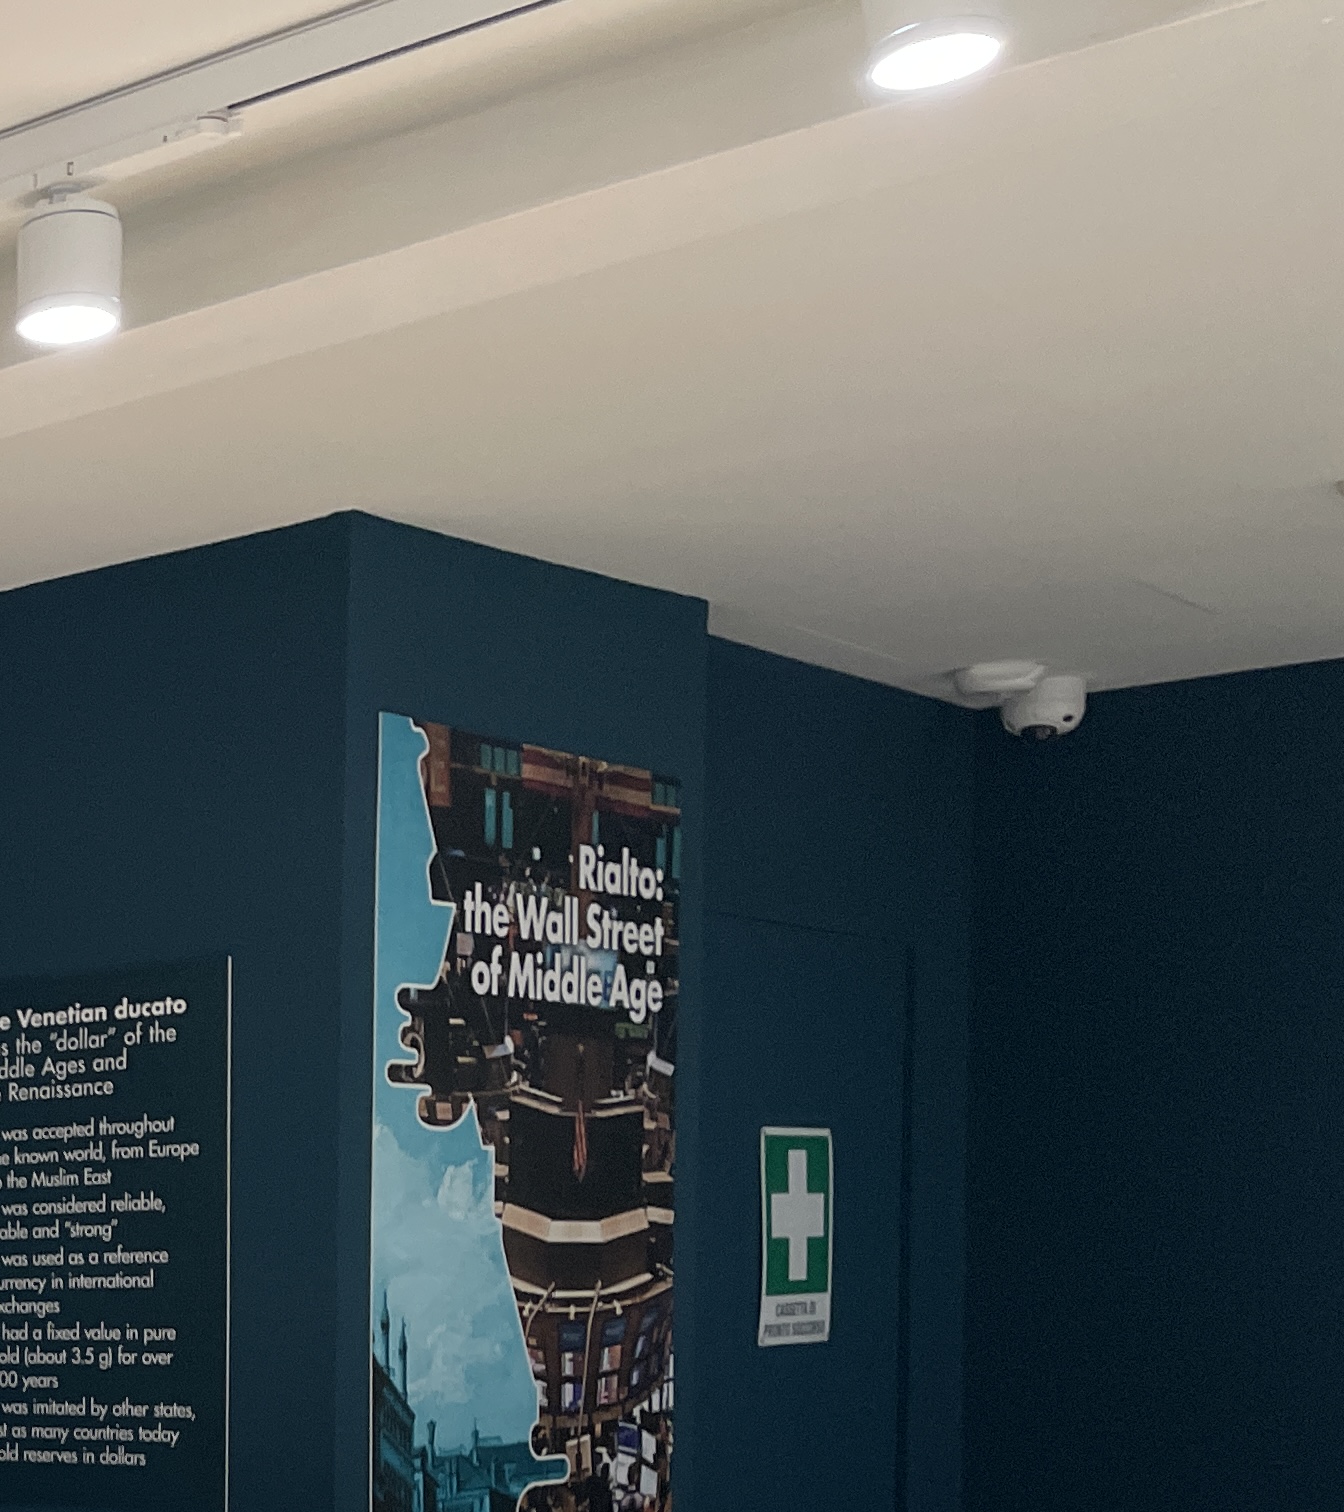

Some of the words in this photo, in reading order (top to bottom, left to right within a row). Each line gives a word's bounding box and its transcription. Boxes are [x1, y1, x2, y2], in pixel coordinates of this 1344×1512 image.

[578, 844, 664, 901] Rialto:
[464, 881, 509, 938] the
[515, 892, 579, 945] Wall
[586, 902, 665, 956] Street
[471, 944, 502, 996] of
[508, 951, 603, 1006] Middle
[609, 963, 663, 1024] Age
[16, 1002, 107, 1028] Venetian
[114, 996, 187, 1020] ducato
[16, 1032, 42, 1055] the
[124, 1021, 143, 1046] of
[149, 1020, 177, 1043] the
[41, 1056, 86, 1081] Ages
[92, 1047, 127, 1072] and
[9, 1079, 114, 1102] Renaissance
[1, 1129, 28, 1141] was
[32, 1117, 94, 1143] accepted
[99, 1113, 175, 1139] throughout
[14, 1146, 59, 1165] known
[111, 1139, 144, 1160] from
[149, 1139, 199, 1162] Europe
[7, 1170, 27, 1188] the
[31, 1167, 79, 1188] Muslim
[84, 1167, 112, 1185] East
[1, 1203, 28, 1216] was
[32, 1193, 106, 1215] considered
[32, 1219, 59, 1239] and
[51, 1272, 63, 1289] in
[68, 1268, 154, 1289] international
[1, 1403, 28, 1415] was
[33, 1396, 86, 1416] imitated
[91, 1397, 108, 1421] by
[112, 1397, 149, 1417] other
[12, 1426, 27, 1438] as
[31, 1427, 69, 1444] many
[73, 1423, 134, 1441] countries
[139, 1422, 180, 1448] today
[24, 1450, 78, 1464] reserves
[83, 1447, 95, 1464] in
[100, 1445, 146, 1466] dollars
